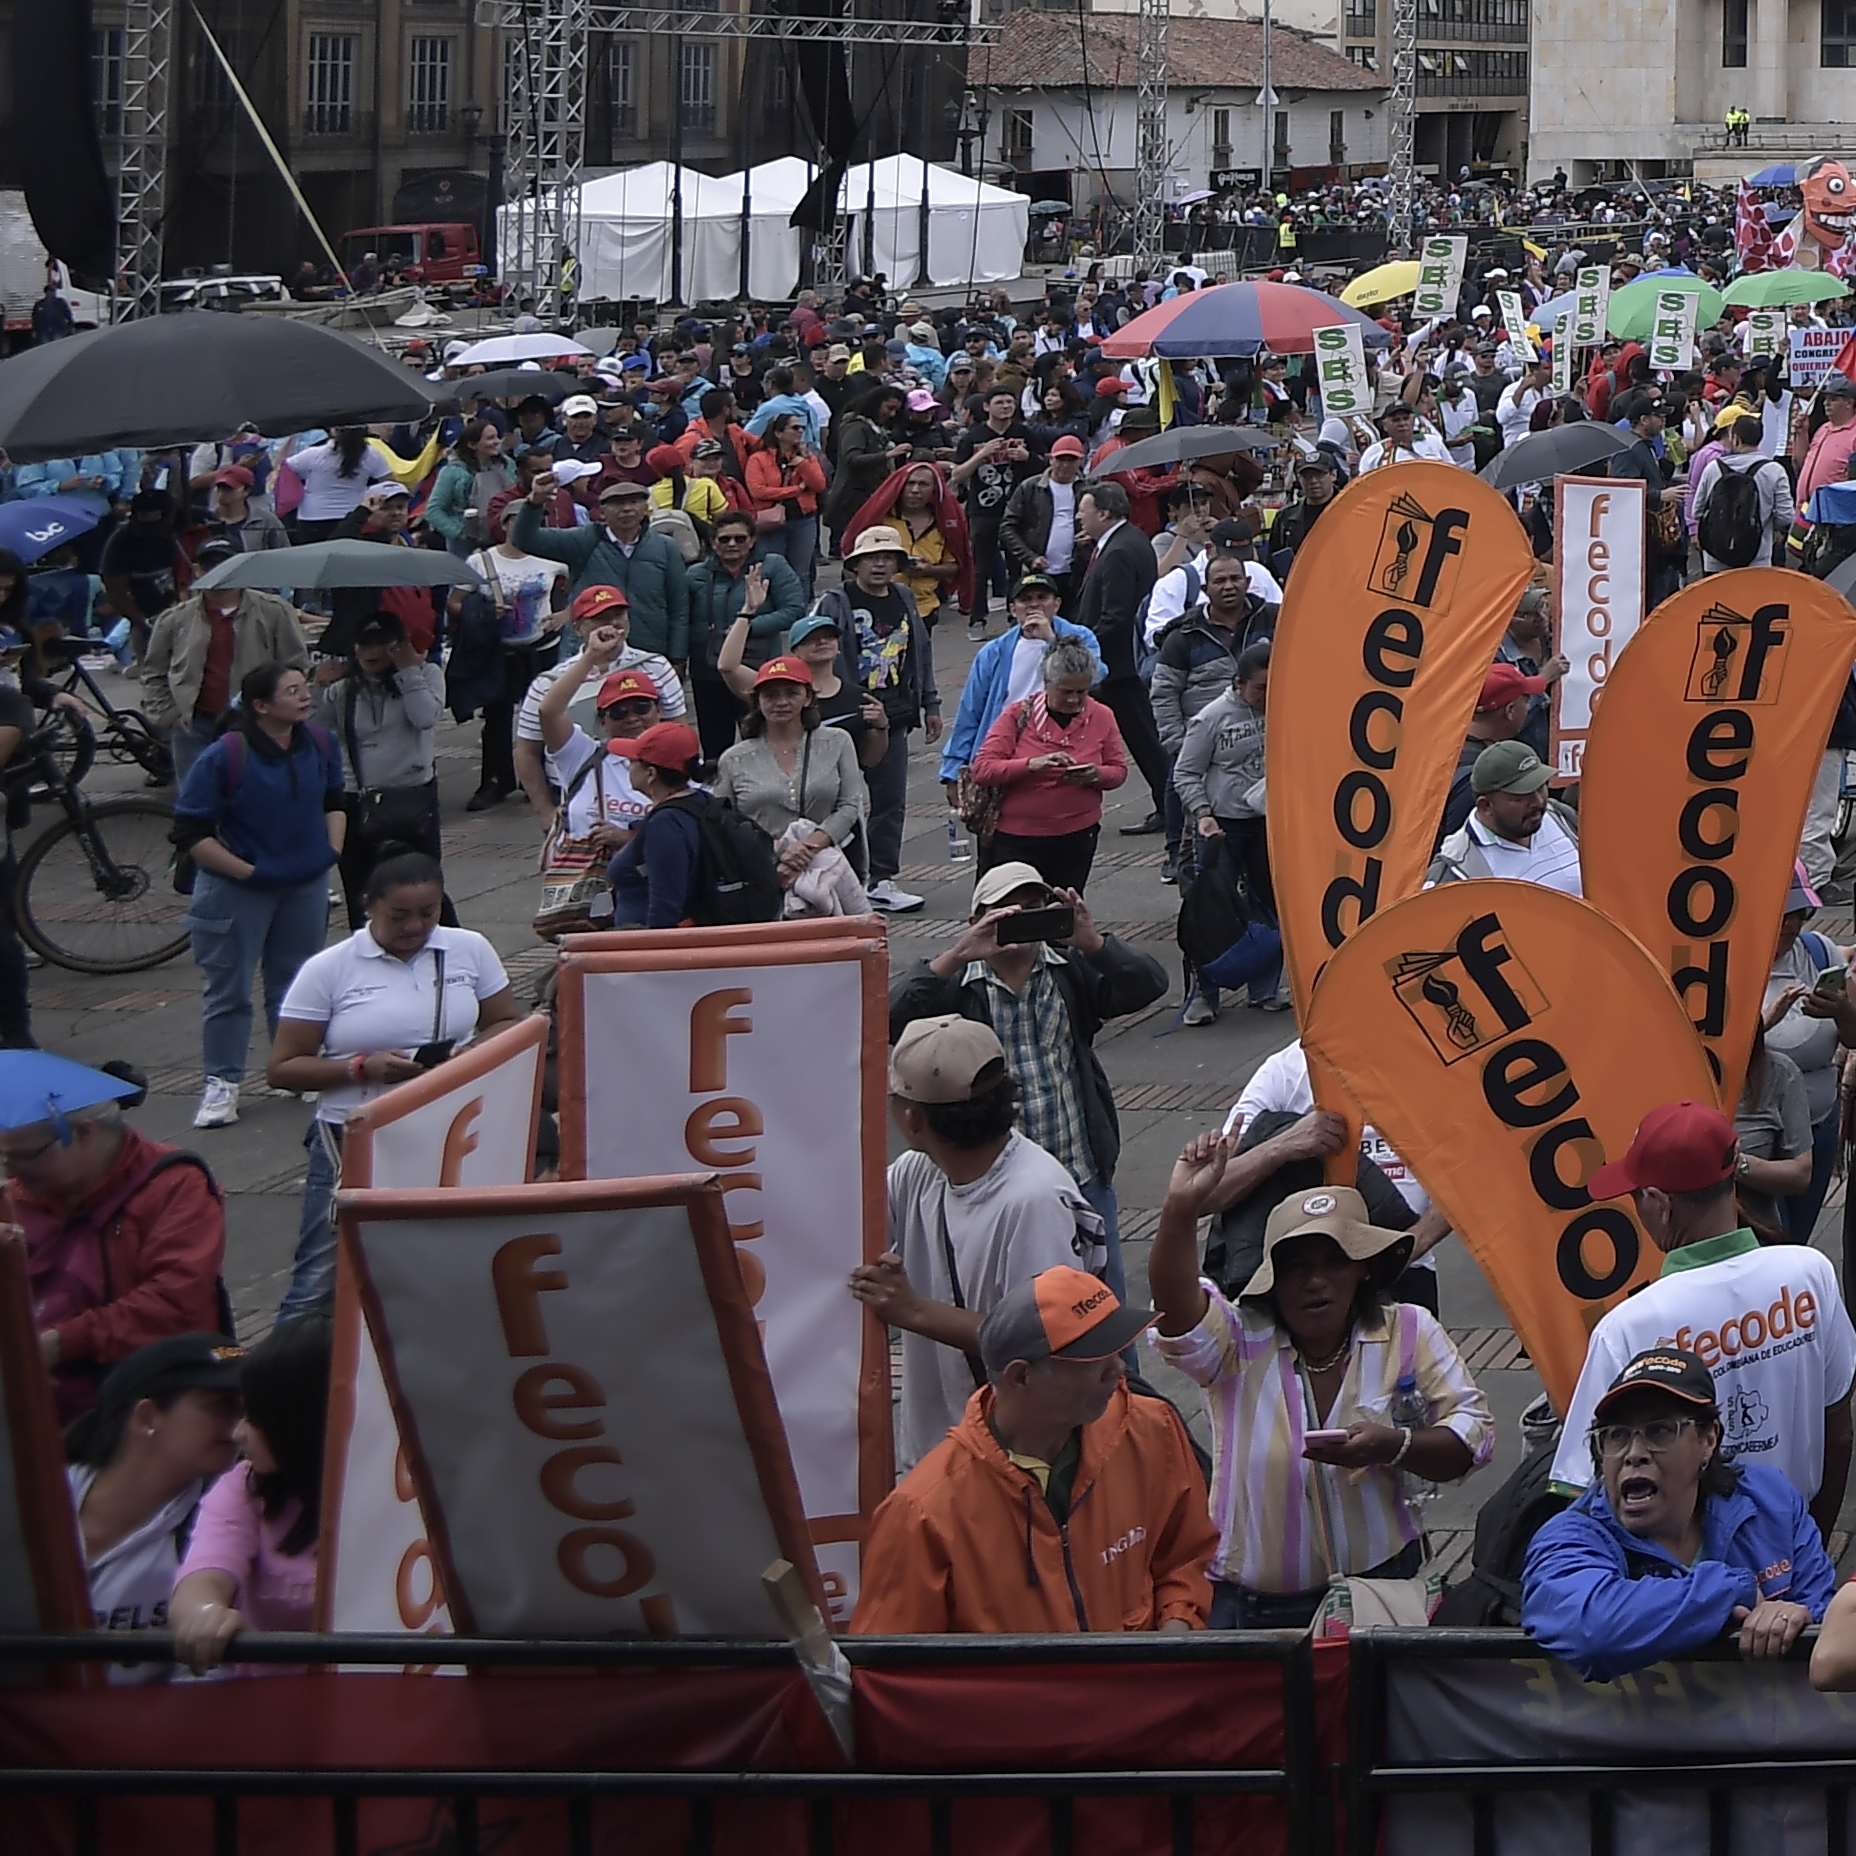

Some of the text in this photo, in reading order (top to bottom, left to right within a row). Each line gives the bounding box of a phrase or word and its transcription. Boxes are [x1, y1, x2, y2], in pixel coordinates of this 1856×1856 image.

[1417, 238, 1451, 312] SES
[1575, 269, 1600, 340] SES
[1500, 293, 1526, 356] SES
[1553, 314, 1568, 391] SES
[1654, 293, 1686, 365] SES
[1751, 314, 1775, 353] SE
[1804, 331, 1851, 347] ABAJO
[1318, 328, 1356, 412] SES
[1311, 506, 1468, 989] fecod
[1665, 603, 1790, 1092] fecod
[1482, 912, 1648, 1302] feco
[684, 986, 767, 1339] fec
[1361, 1138, 1397, 1155] BE
[1675, 1284, 1816, 1368] fecode
[1761, 1348, 1772, 1362] DE
[492, 1232, 677, 1635] feco
[1101, 1536, 1129, 1565] ING
